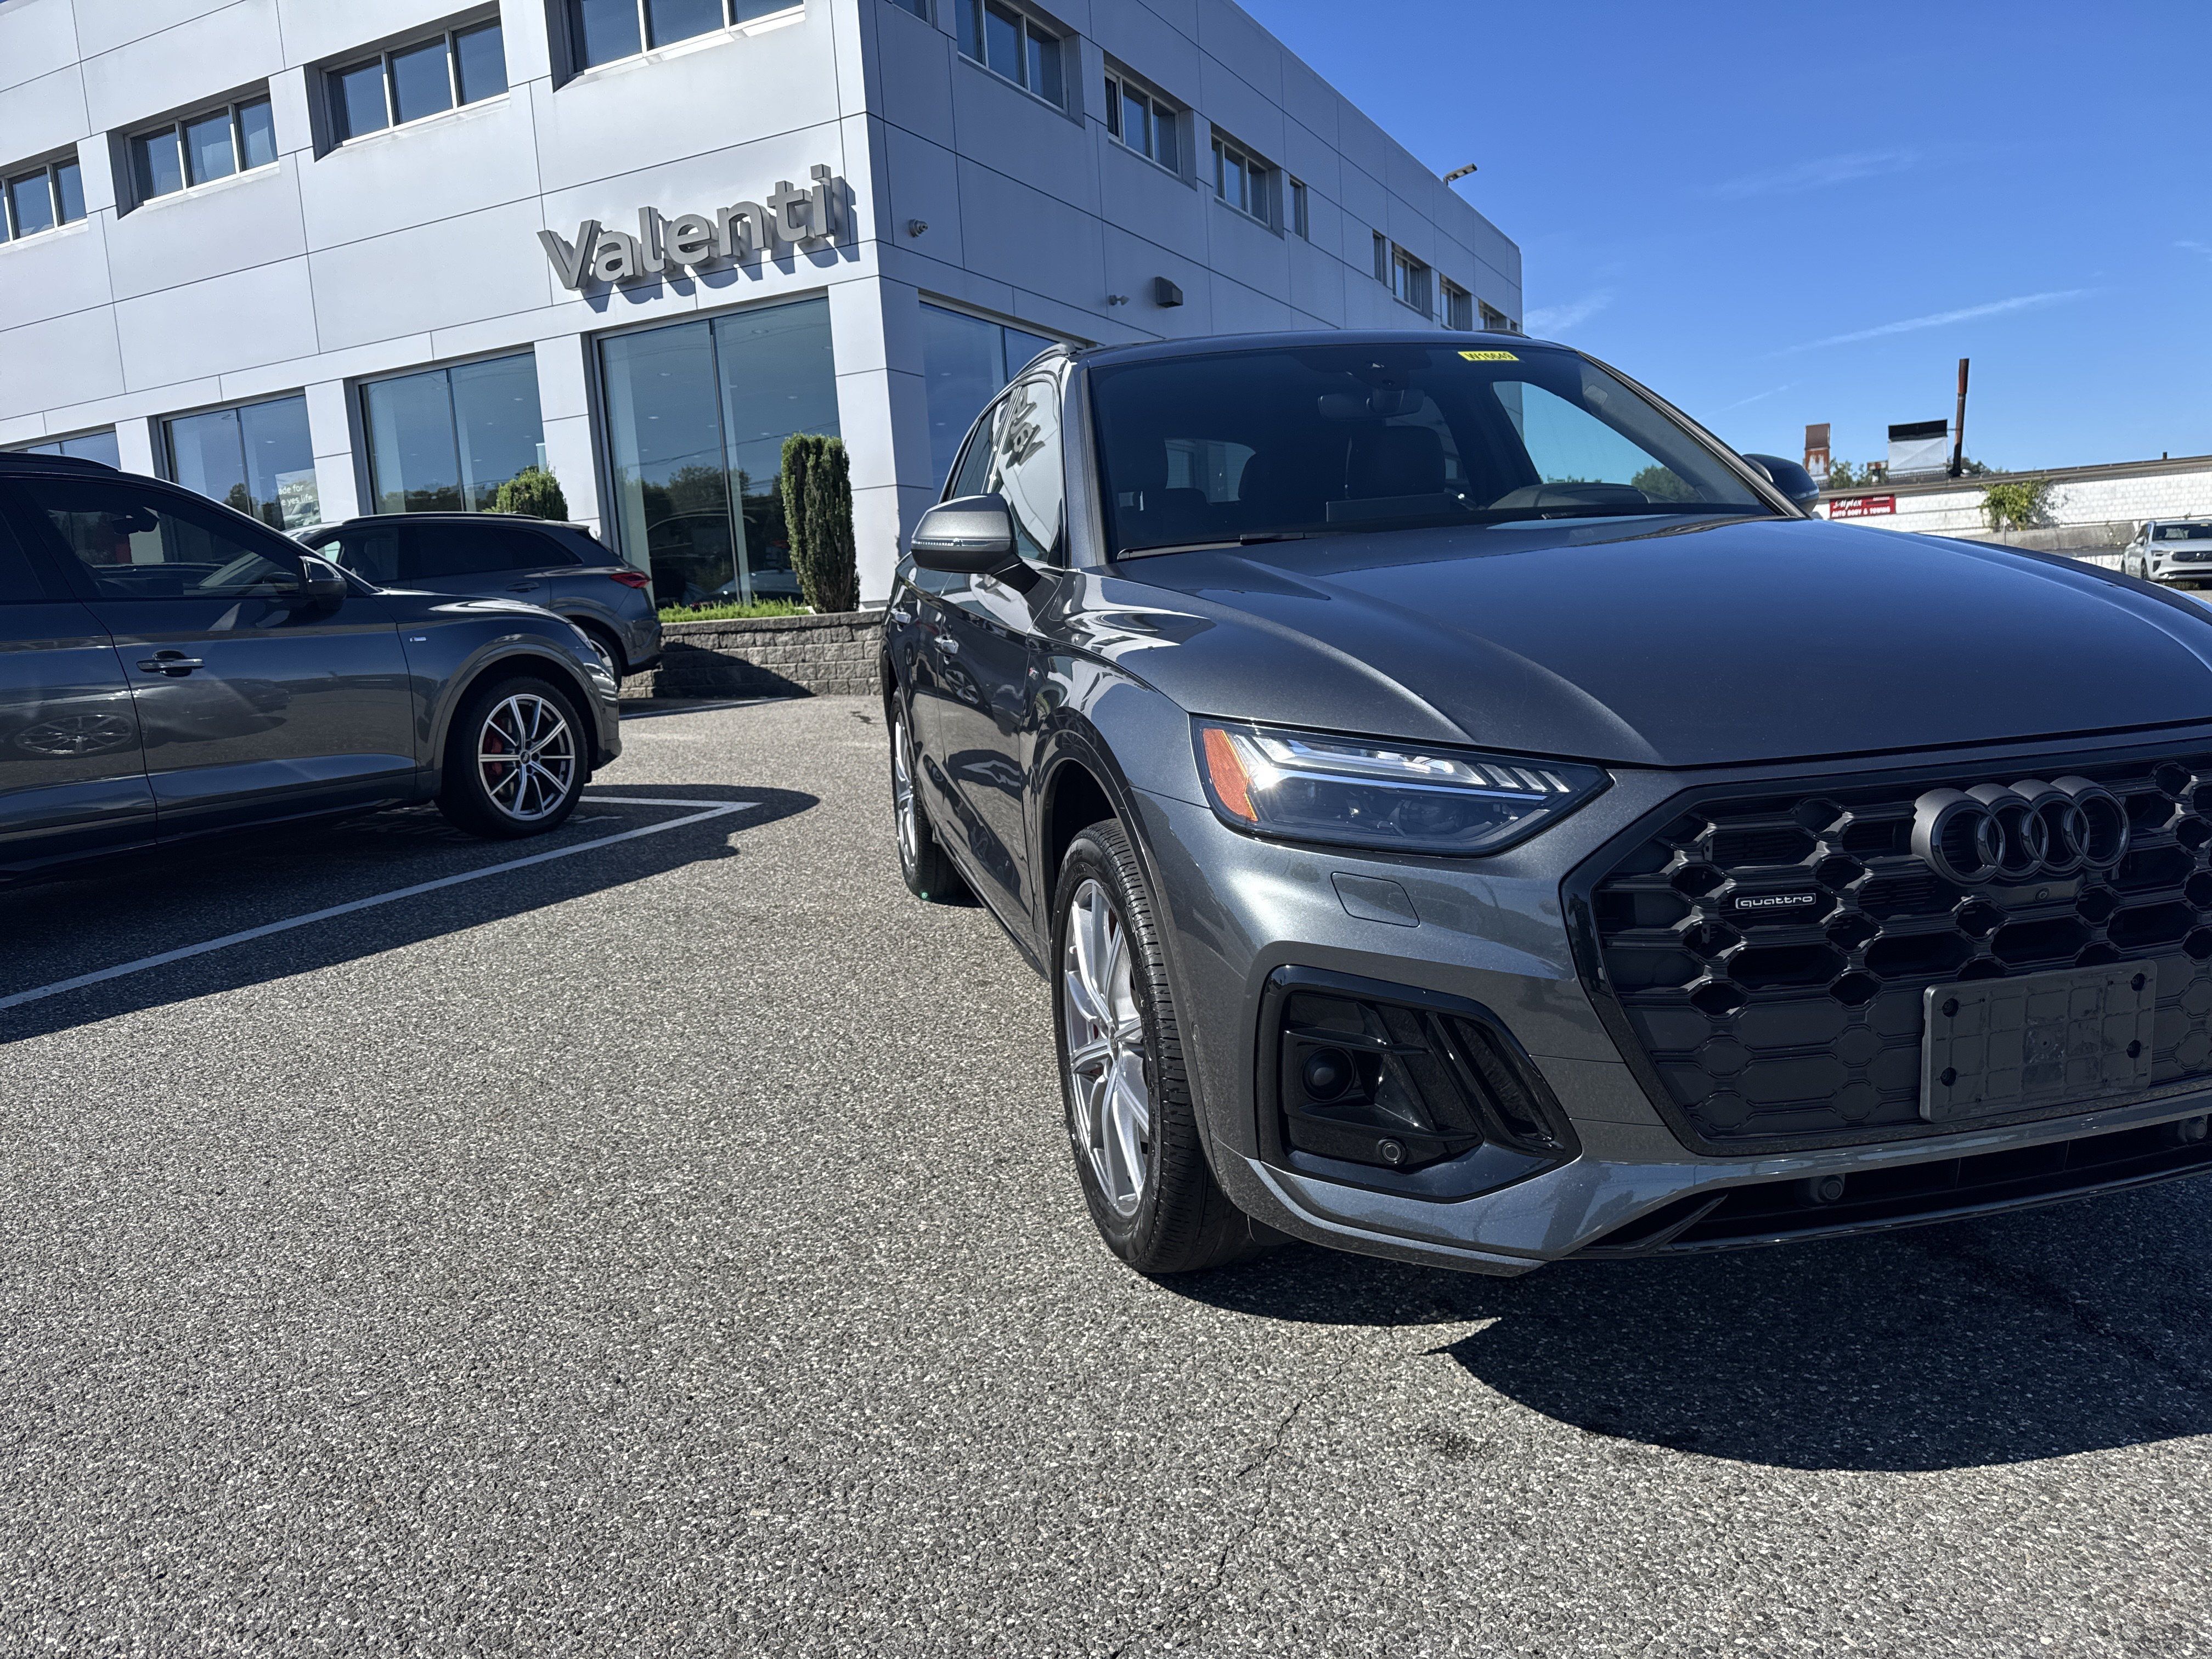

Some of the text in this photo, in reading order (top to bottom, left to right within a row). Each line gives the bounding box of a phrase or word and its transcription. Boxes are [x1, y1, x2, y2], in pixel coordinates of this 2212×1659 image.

[537, 164, 836, 291] Valenti
[278, 484, 304, 494] ade for
[287, 496, 300, 507] yes
[301, 493, 313, 502] life
[1847, 508, 1863, 516] BODY
[1869, 506, 1891, 514] TOWING
[1740, 895, 1813, 907] quattro
